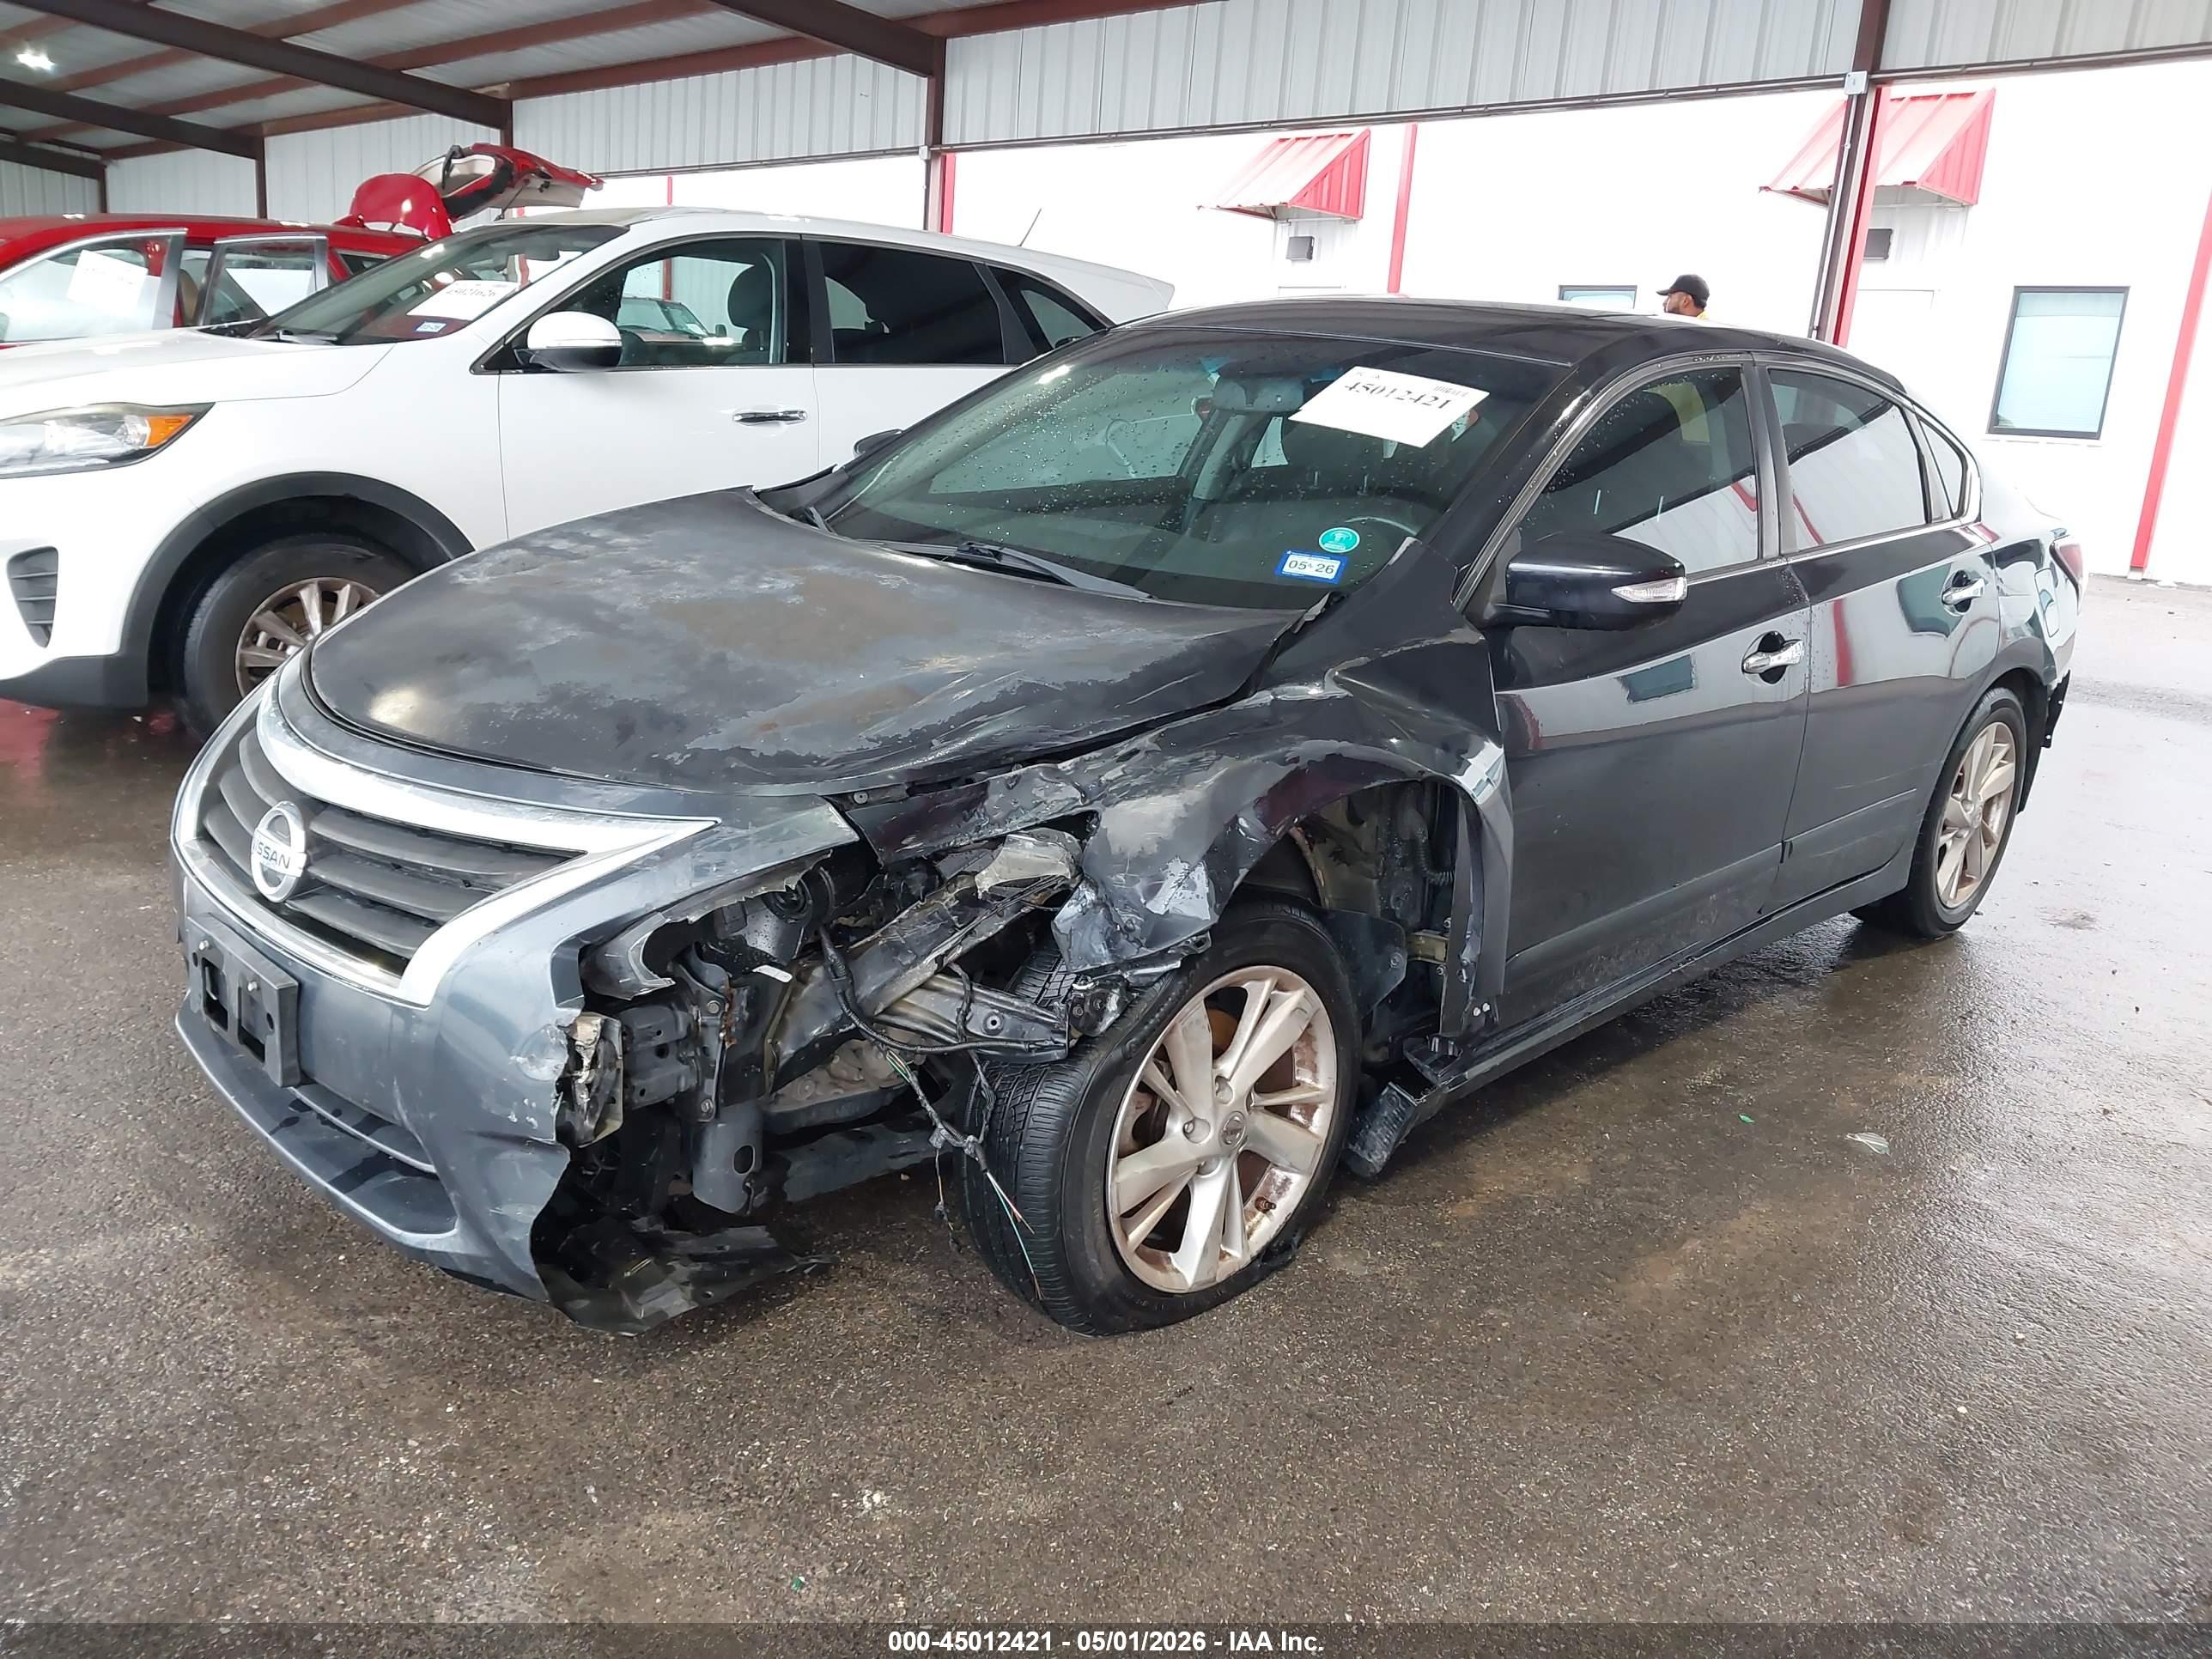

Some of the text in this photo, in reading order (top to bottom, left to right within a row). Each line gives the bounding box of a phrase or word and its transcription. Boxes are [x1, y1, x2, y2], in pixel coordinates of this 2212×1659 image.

[1344, 381, 1452, 410] 45012421
[1288, 559, 1335, 574] 05 26
